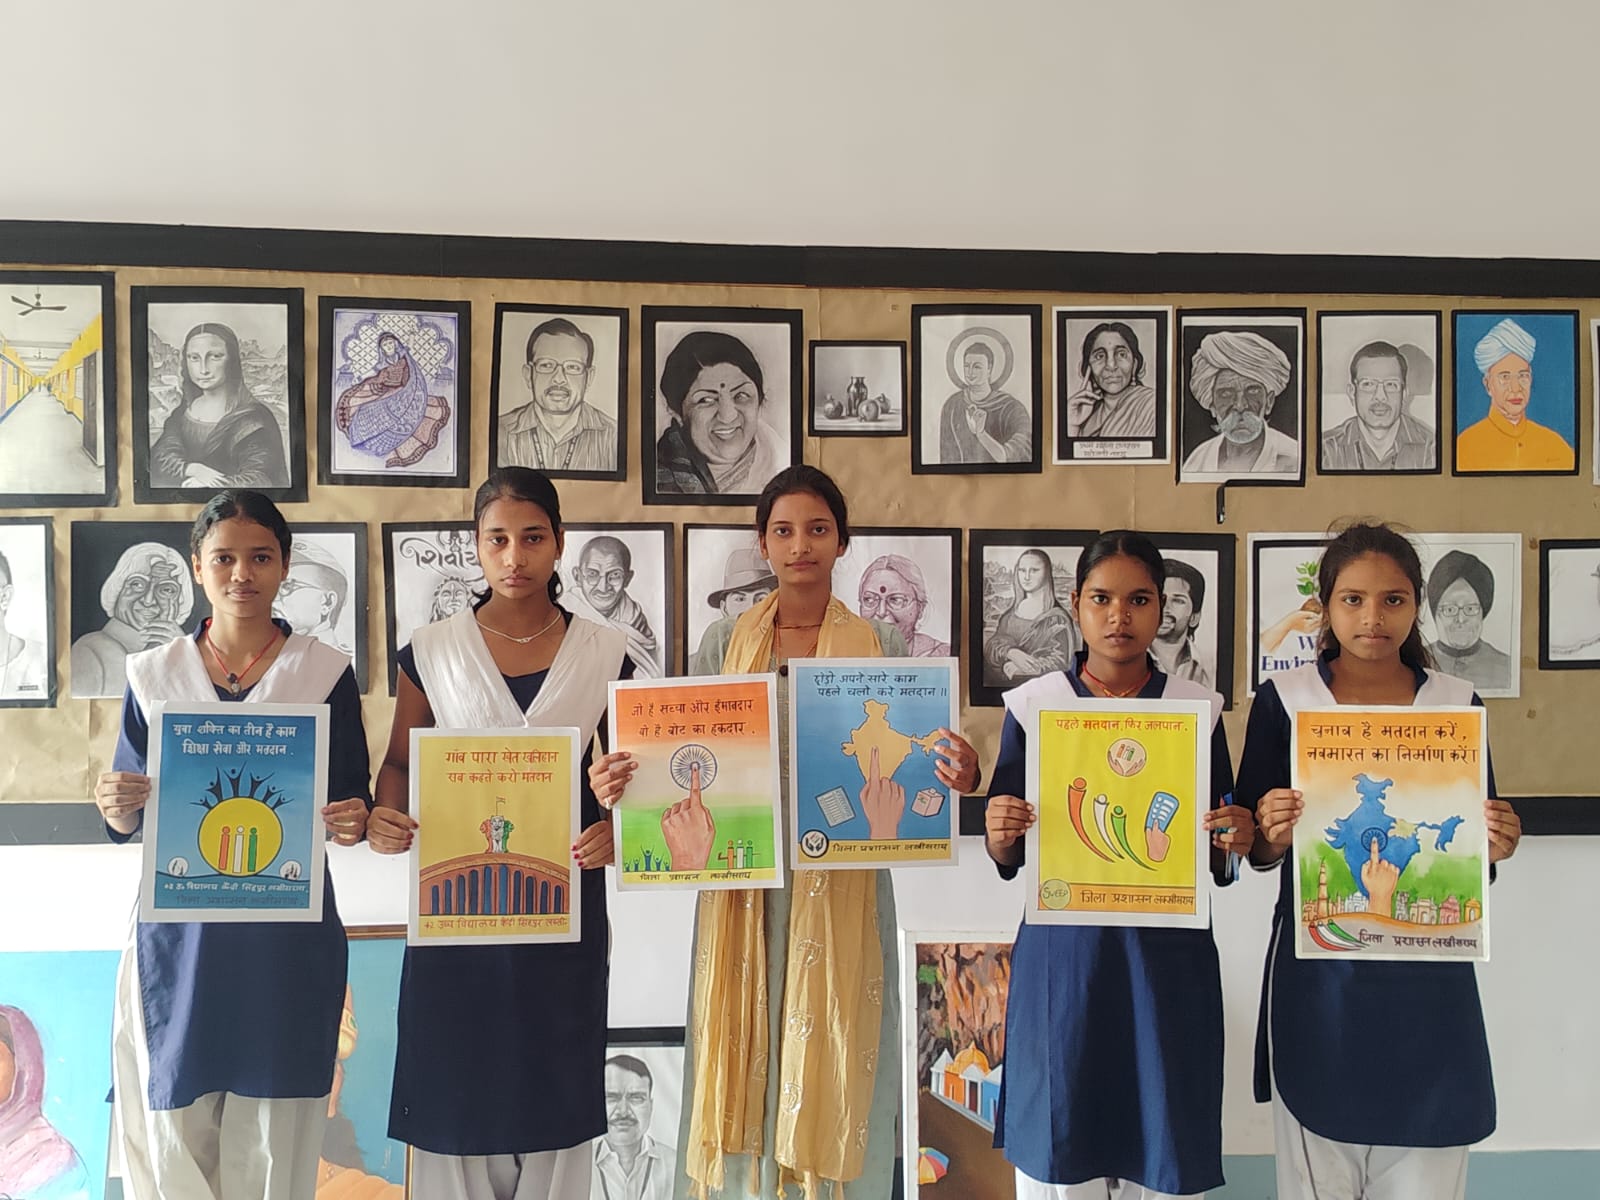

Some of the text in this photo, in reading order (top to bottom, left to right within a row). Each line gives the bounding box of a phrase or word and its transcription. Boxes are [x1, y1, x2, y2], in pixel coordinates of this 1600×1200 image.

[840, 671, 867, 684] अपने
[867, 671, 889, 684] सारे
[893, 674, 918, 683] काम
[817, 685, 841, 697] पहले
[847, 685, 871, 696] चलो
[631, 703, 643, 716] जो
[660, 703, 686, 715] सच्चा
[690, 699, 710, 715] और
[197, 720, 225, 735] शक्ति
[228, 724, 241, 735] का
[243, 721, 264, 736] तीन
[275, 726, 297, 737] काम
[692, 724, 706, 735] का
[1056, 717, 1080, 730] पहले
[1125, 716, 1141, 730] फिर
[1310, 724, 1354, 739] चुनाव
[1360, 721, 1372, 740] है
[1381, 724, 1430, 740] मतदान
[182, 738, 209, 754] शिक्षा
[213, 741, 232, 755] सेवा
[236, 741, 251, 755] और
[1371, 747, 1392, 762] का
[1395, 744, 1446, 763] निर्माण
[501, 747, 521, 764] खेत
[522, 749, 559, 763] खलिहान
[468, 769, 494, 784] कहते
[496, 768, 521, 784] करो
[522, 771, 553, 783] मतदान
[1080, 889, 1107, 904] जिला
[1111, 892, 1152, 905] प्रशासन
[457, 917, 497, 929] विद्यालय
[1359, 929, 1384, 943] जिला
